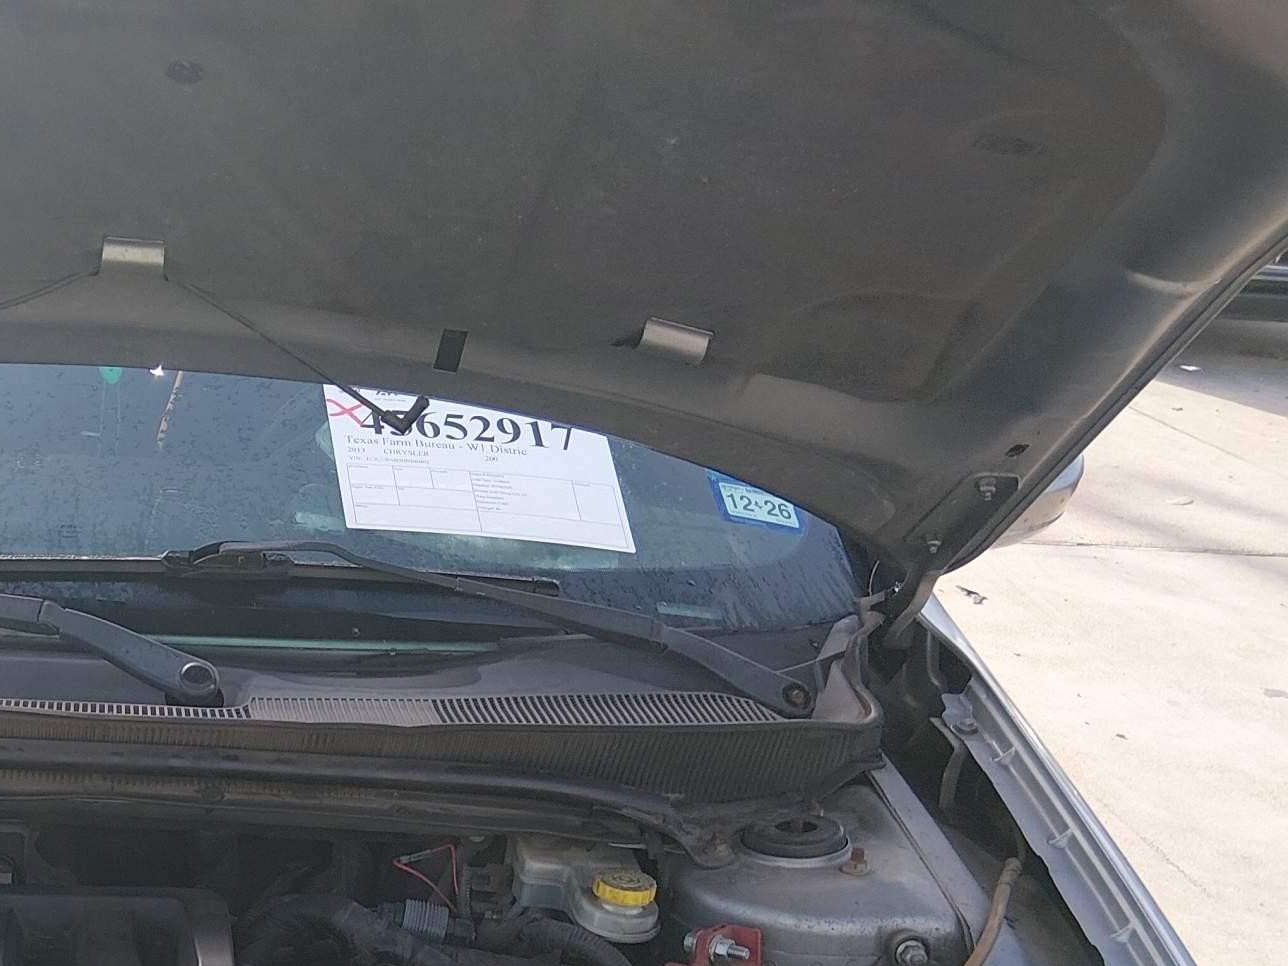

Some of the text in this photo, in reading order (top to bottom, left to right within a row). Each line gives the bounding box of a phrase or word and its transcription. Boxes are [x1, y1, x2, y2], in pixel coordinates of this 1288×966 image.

[346, 434, 379, 446] Texas
[382, 437, 411, 448] Farm
[415, 438, 455, 450] Bureau
[383, 448, 430, 458] CHRYSLER
[726, 493, 792, 520] 12 26
